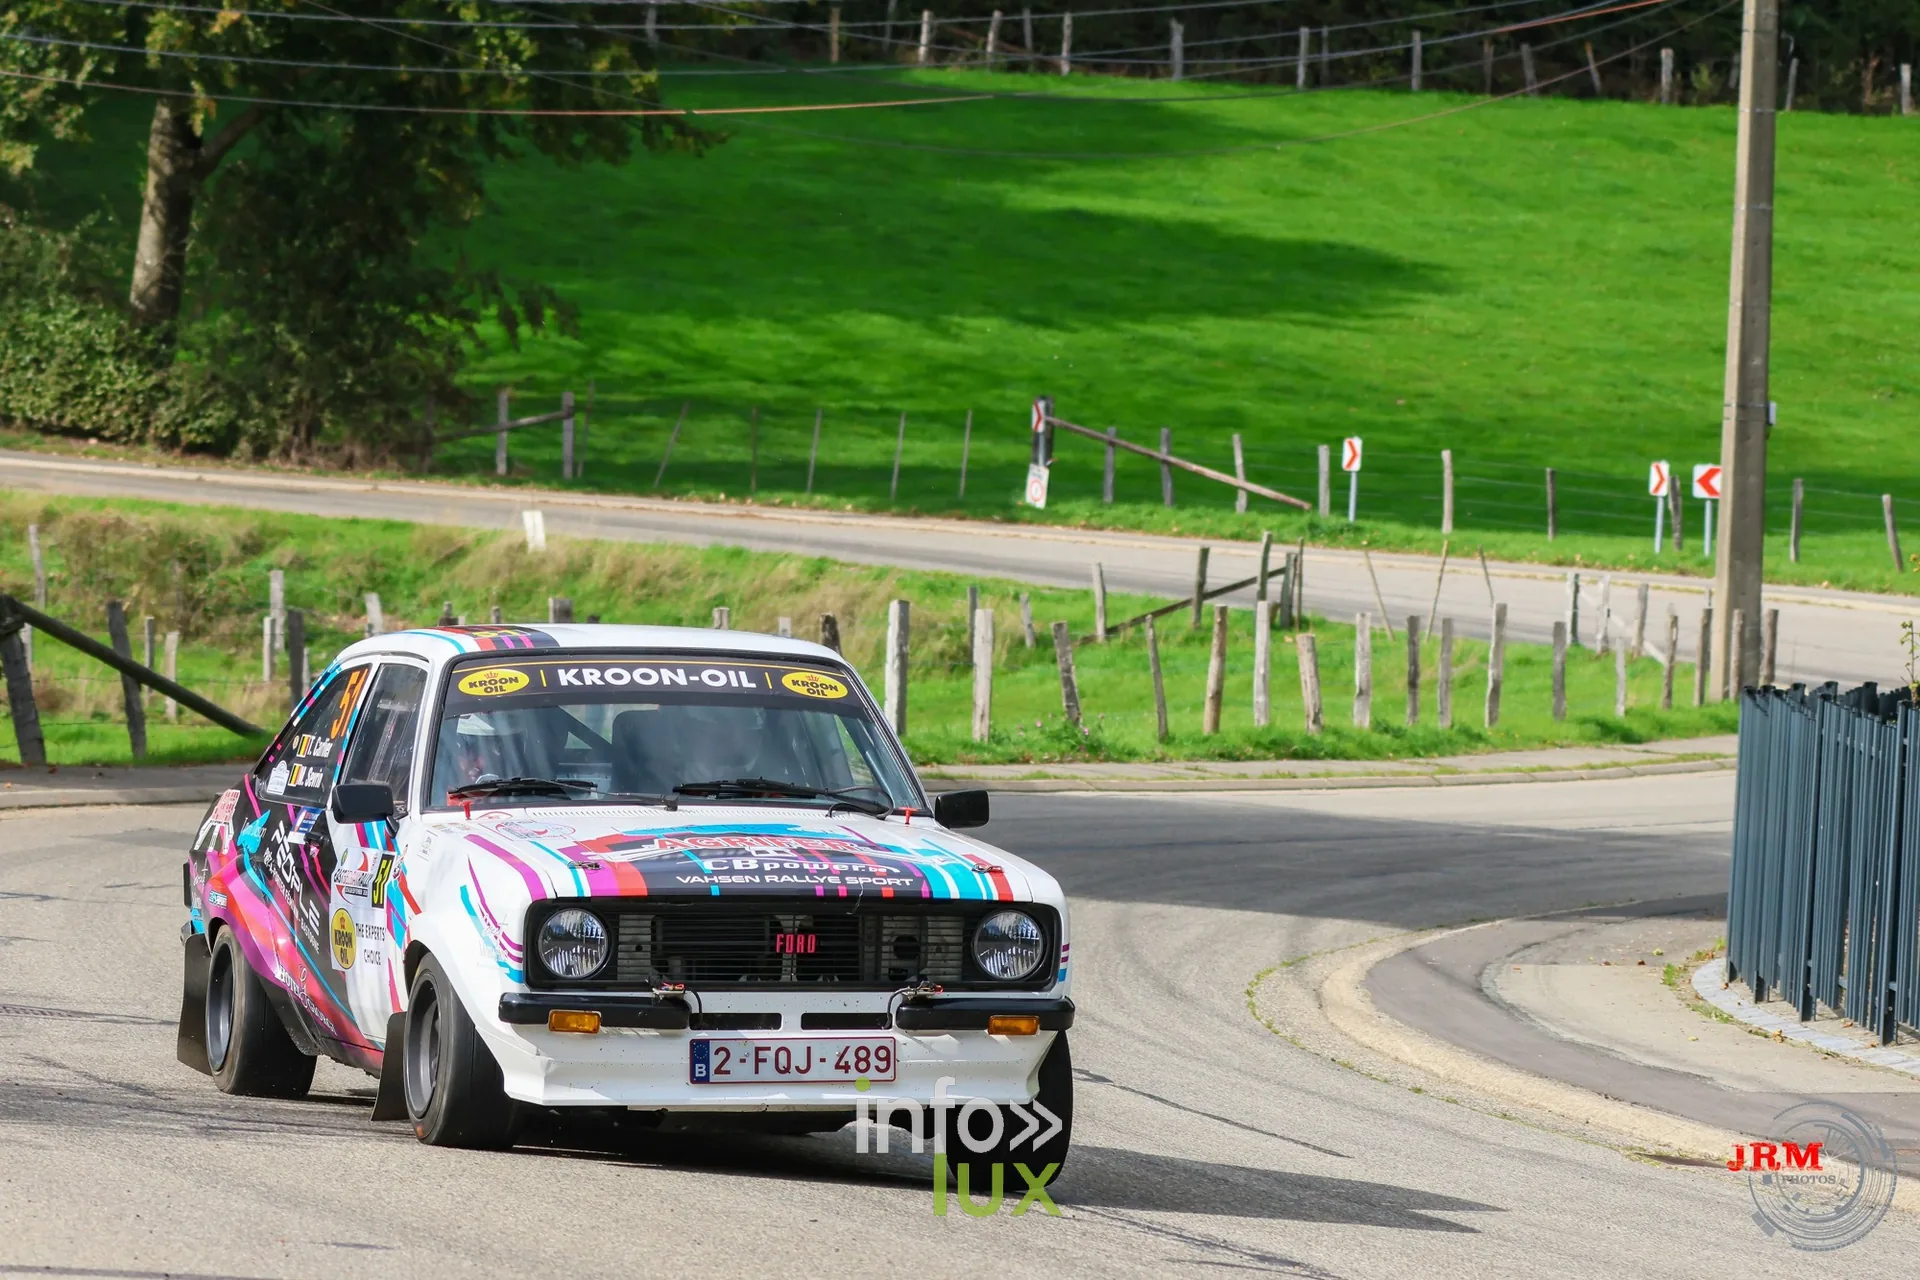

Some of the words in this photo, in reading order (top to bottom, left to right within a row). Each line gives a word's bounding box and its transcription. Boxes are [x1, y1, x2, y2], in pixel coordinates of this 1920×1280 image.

[468, 676, 519, 689] KROON
[557, 667, 757, 688] KROON-OIL
[791, 679, 840, 692] KROON
[483, 685, 507, 694] OIL
[806, 687, 829, 697] OIL
[330, 668, 369, 740] 51
[654, 836, 856, 852] AGRIFER
[372, 858, 393, 906] 51
[676, 875, 760, 884] VAHSEN
[765, 875, 842, 884] RALLYE
[845, 876, 914, 886] SPORT
[355, 922, 365, 938] THE
[333, 928, 353, 949] KROON
[775, 932, 818, 955] FORD
[339, 946, 349, 965] OIL
[363, 948, 382, 966] CHOICE
[694, 1064, 707, 1077] B
